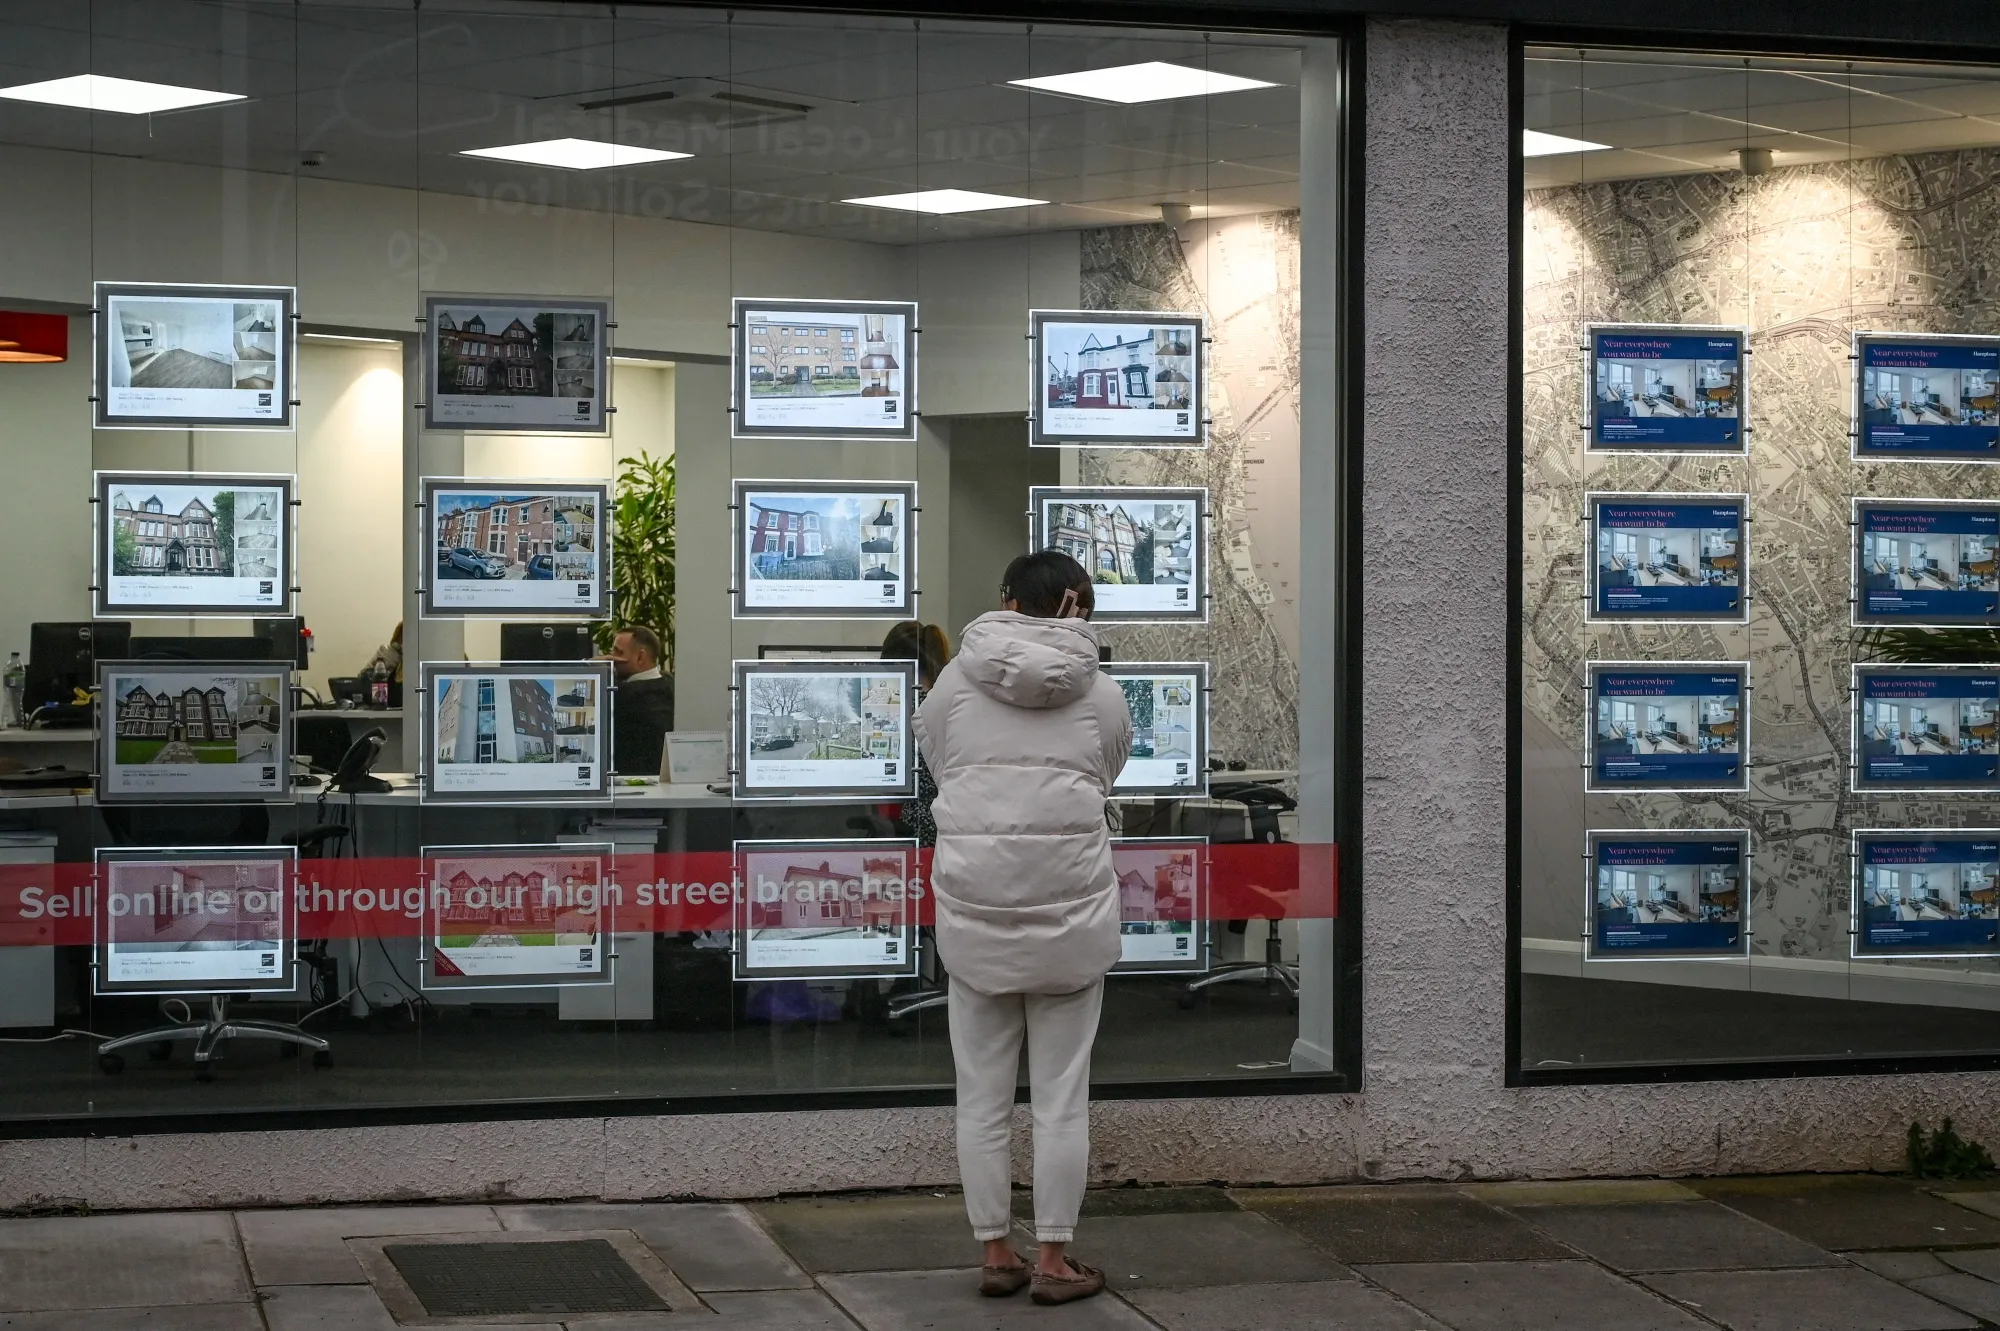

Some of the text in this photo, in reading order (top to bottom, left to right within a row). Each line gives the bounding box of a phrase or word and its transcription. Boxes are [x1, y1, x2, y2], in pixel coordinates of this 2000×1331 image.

[1624, 340, 1672, 350] everywhere
[1892, 350, 1938, 358] everywhere
[1629, 510, 1677, 519] everywhere
[1891, 515, 1937, 524] everywhere
[1628, 678, 1676, 687] everywhere
[1891, 680, 1937, 688] everywhere
[19, 873, 925, 919] Sell online or through our high street branches
